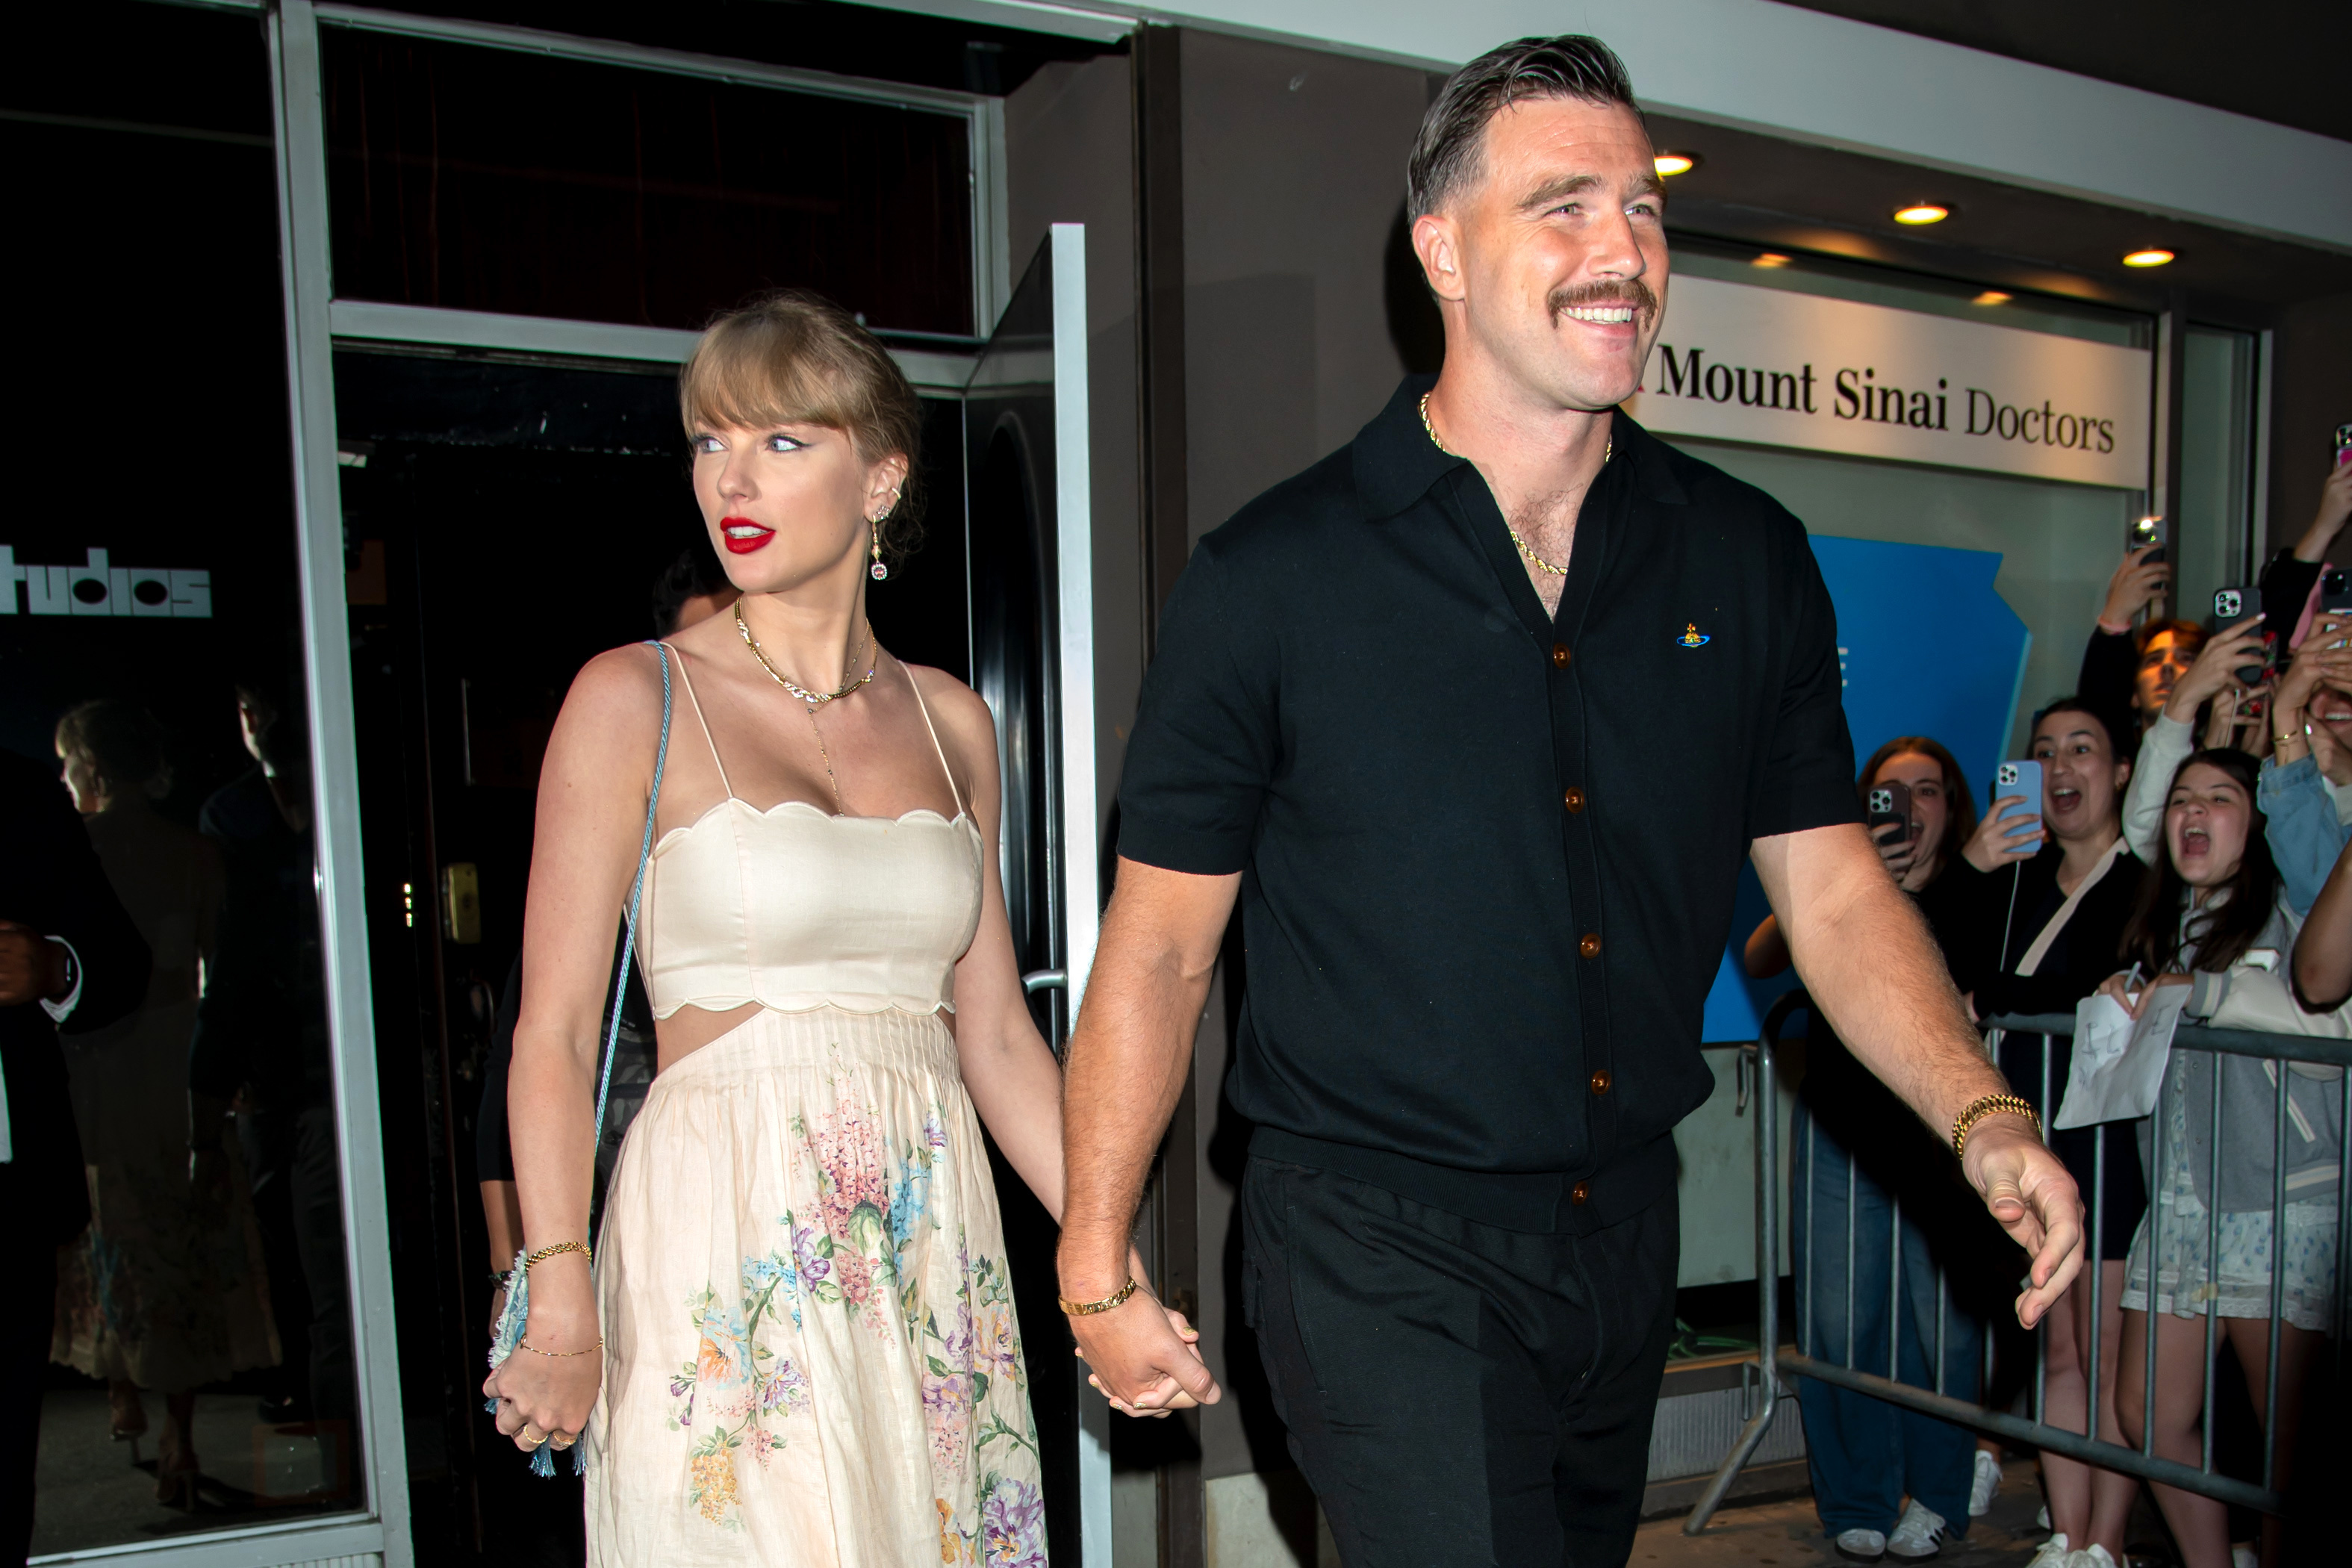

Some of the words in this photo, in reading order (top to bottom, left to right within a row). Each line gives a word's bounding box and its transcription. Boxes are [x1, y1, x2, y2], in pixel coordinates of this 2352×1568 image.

[1656, 343, 1817, 413] Mount
[1834, 367, 1949, 431] Sinai
[1964, 388, 2115, 454] Doctors
